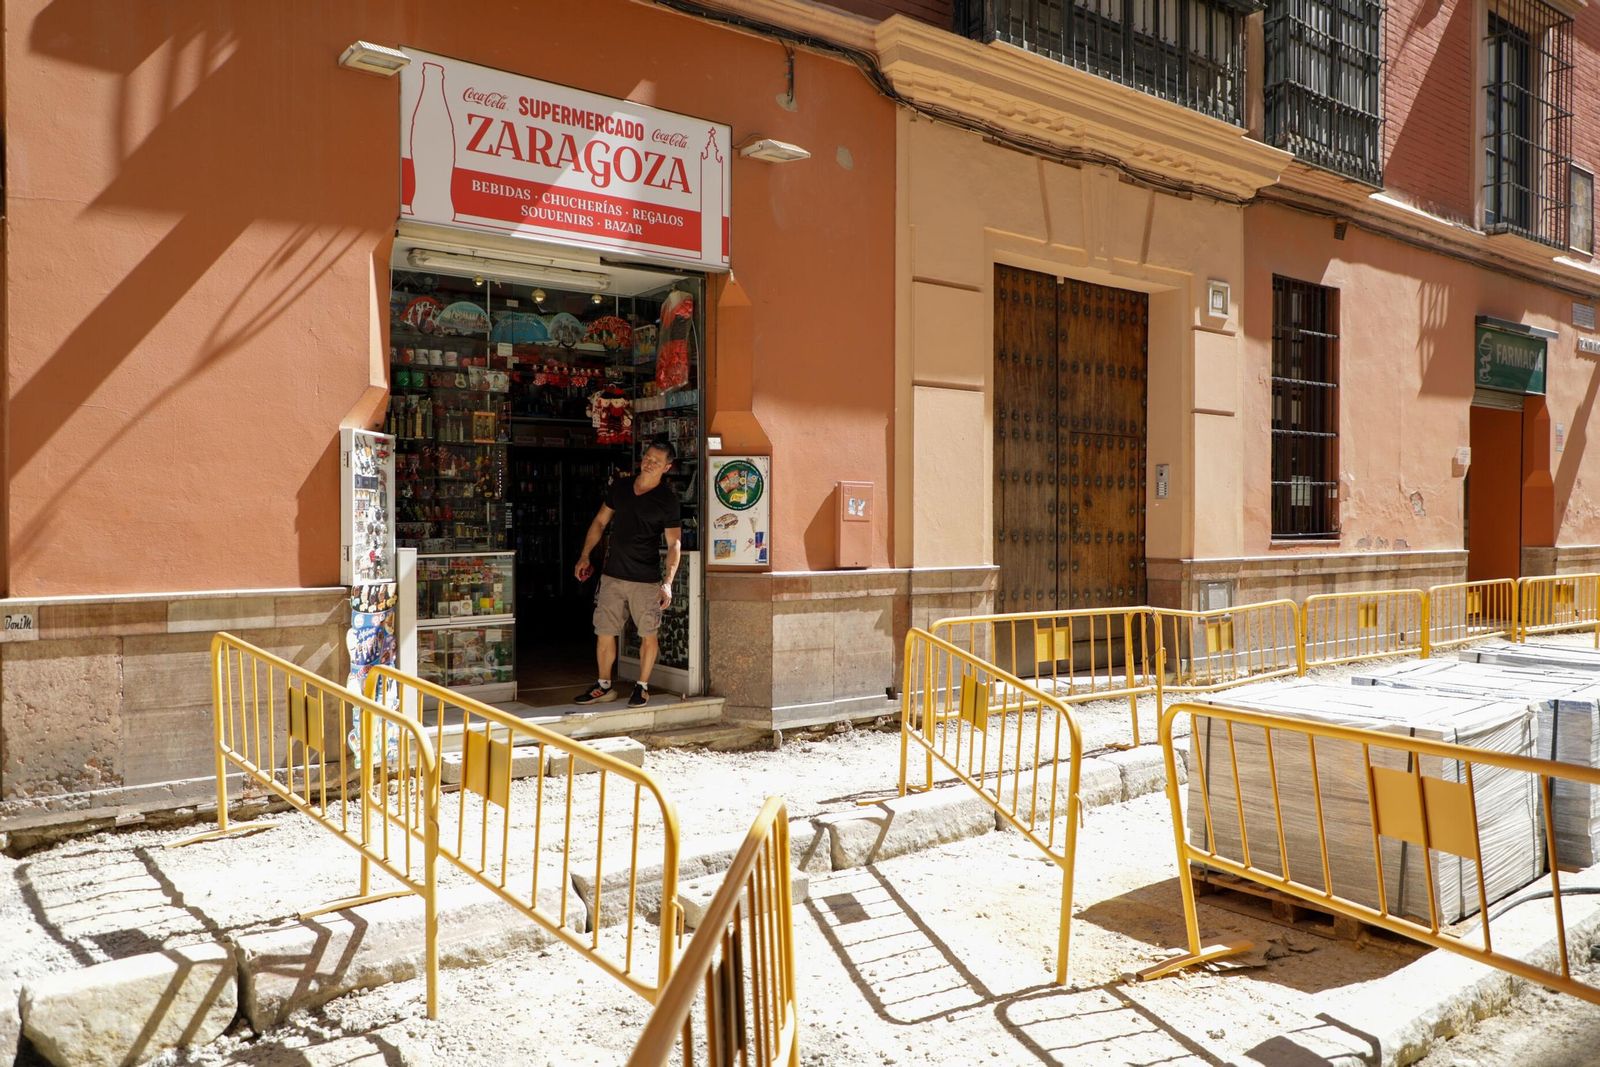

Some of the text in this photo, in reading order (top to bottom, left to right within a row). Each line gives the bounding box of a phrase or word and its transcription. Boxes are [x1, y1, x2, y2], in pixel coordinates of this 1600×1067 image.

[463, 86, 509, 110] Coca-Cola
[518, 95, 645, 142] SUPERMERCADO
[466, 113, 692, 194] ZARAGOZA
[652, 128, 689, 149] Coca-Cola
[472, 180, 684, 227] BEBIDAS CHUCHERÍAS REGALOS
[521, 205, 643, 235] SOUVENIRS BAZAR
[1496, 344, 1544, 372] FARMACIA
